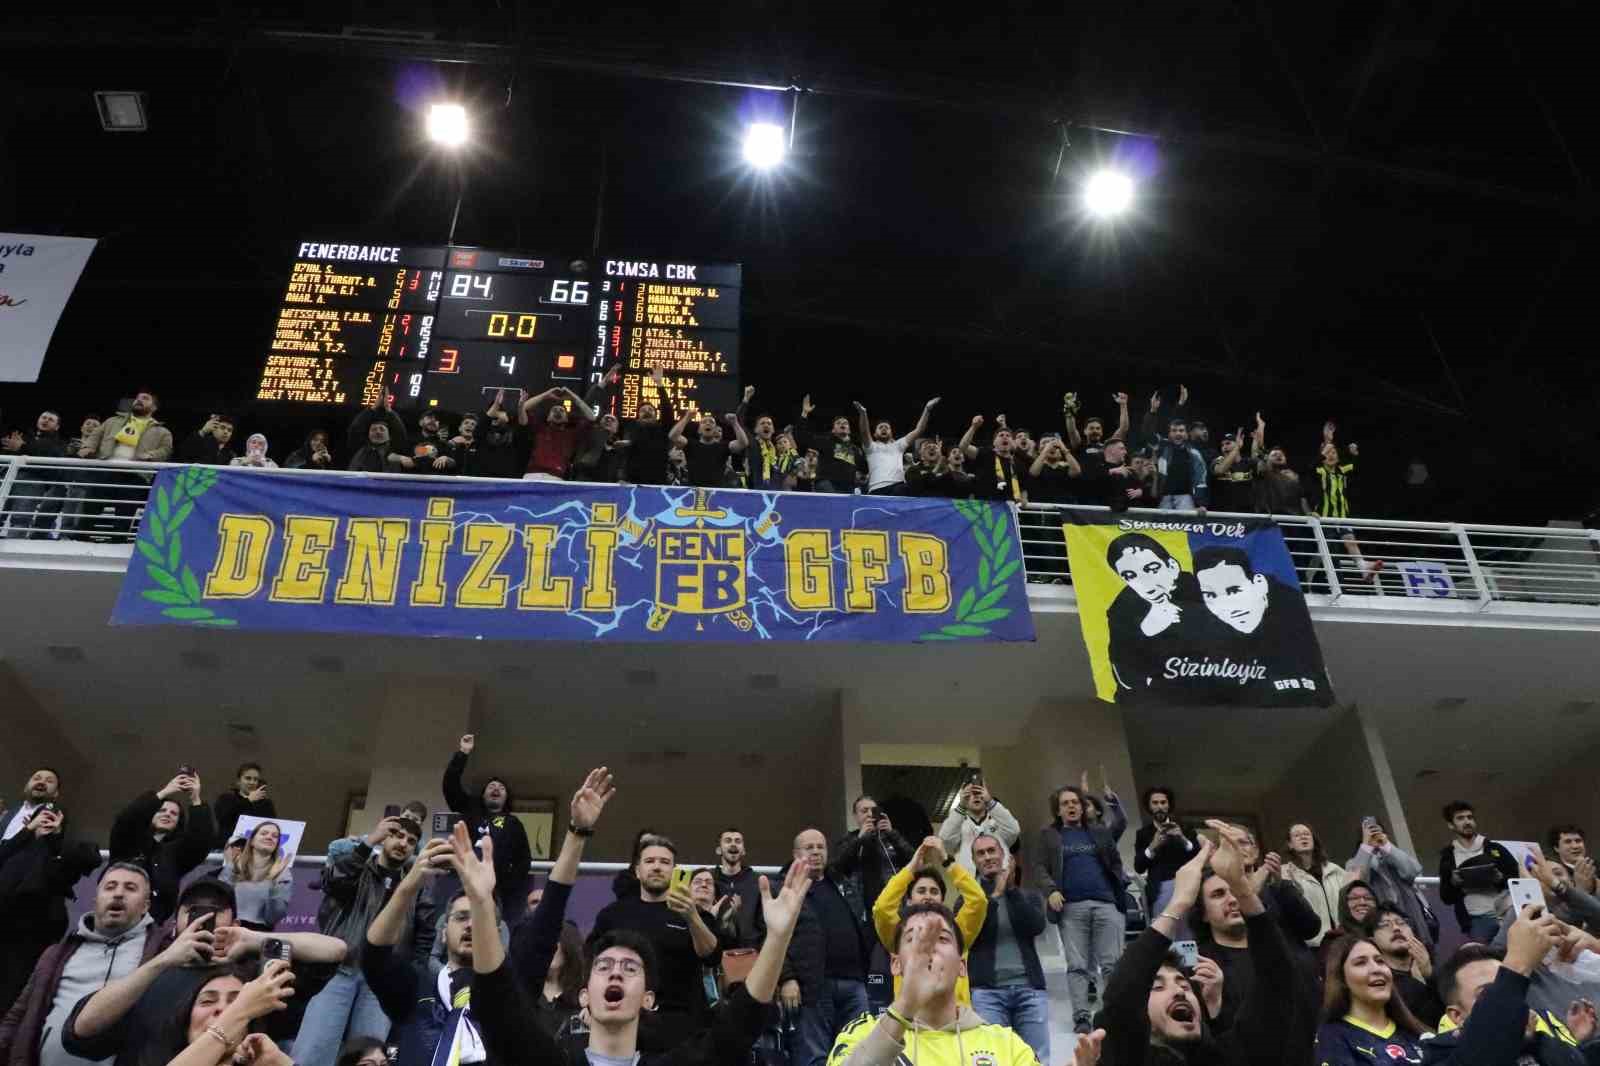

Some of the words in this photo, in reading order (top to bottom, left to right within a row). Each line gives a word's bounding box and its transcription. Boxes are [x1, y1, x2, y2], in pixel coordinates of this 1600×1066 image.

[298, 242, 401, 263] FENERBAHCE
[666, 264, 697, 280] CBK
[451, 274, 493, 297] 84
[550, 279, 590, 304] 66
[602, 280, 611, 292] 3
[388, 298, 400, 309] 10
[600, 300, 608, 310] 6
[401, 314, 411, 325] 2
[600, 310, 608, 320] 6
[598, 325, 607, 336] 5
[632, 328, 642, 338] 10
[596, 346, 605, 356] 3
[438, 349, 459, 372] 3
[500, 355, 516, 375] 4
[630, 358, 640, 369] 18
[410, 373, 422, 384] 10
[624, 374, 640, 384] 22
[410, 384, 420, 397] 8
[1207, 521, 1246, 539] Dek
[202, 497, 618, 611] DENİZLİ
[784, 528, 953, 614] GFB
[661, 563, 741, 610] FB
[1163, 656, 1267, 685] Sizinleyiz
